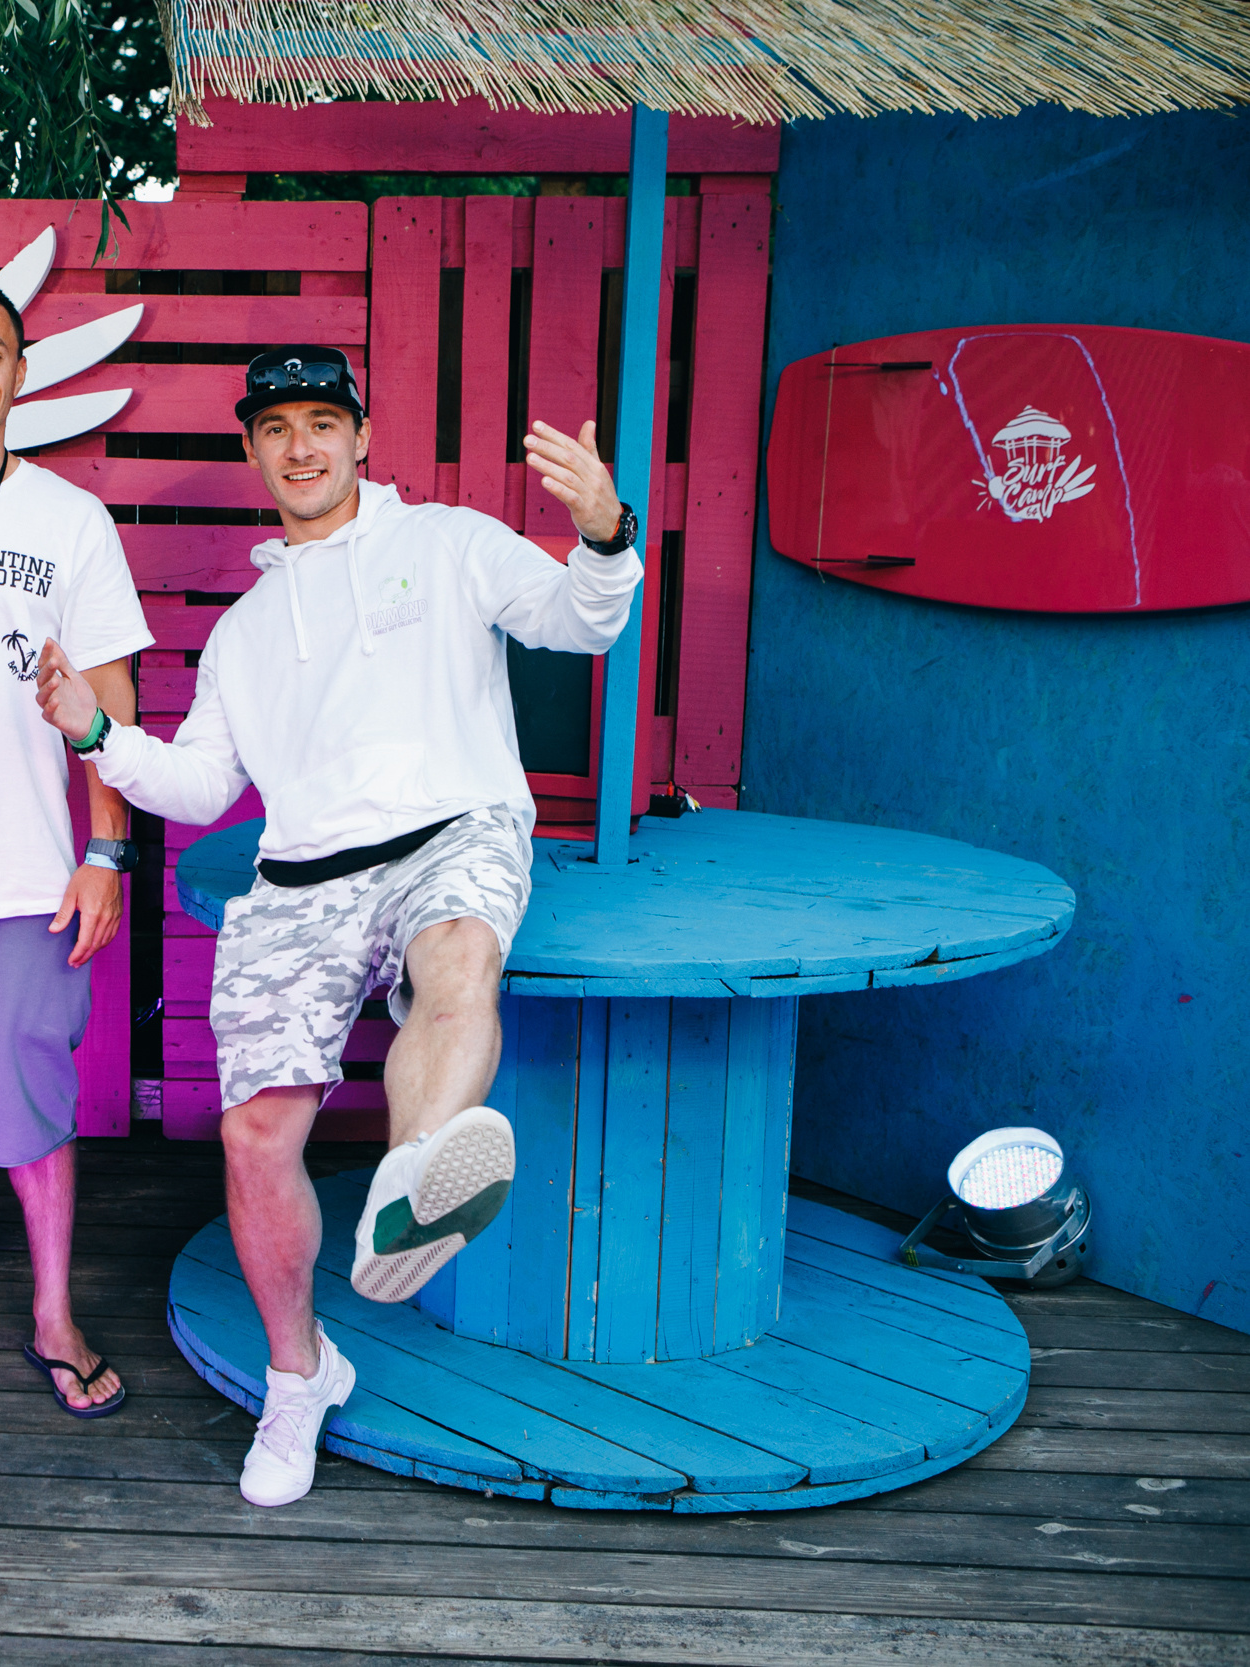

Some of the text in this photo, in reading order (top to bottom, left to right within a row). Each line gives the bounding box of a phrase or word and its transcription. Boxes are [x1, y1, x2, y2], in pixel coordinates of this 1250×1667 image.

[1003, 455, 1066, 486] Surf
[1003, 482, 1064, 519] Camp
[364, 598, 428, 631] DIAMOND
